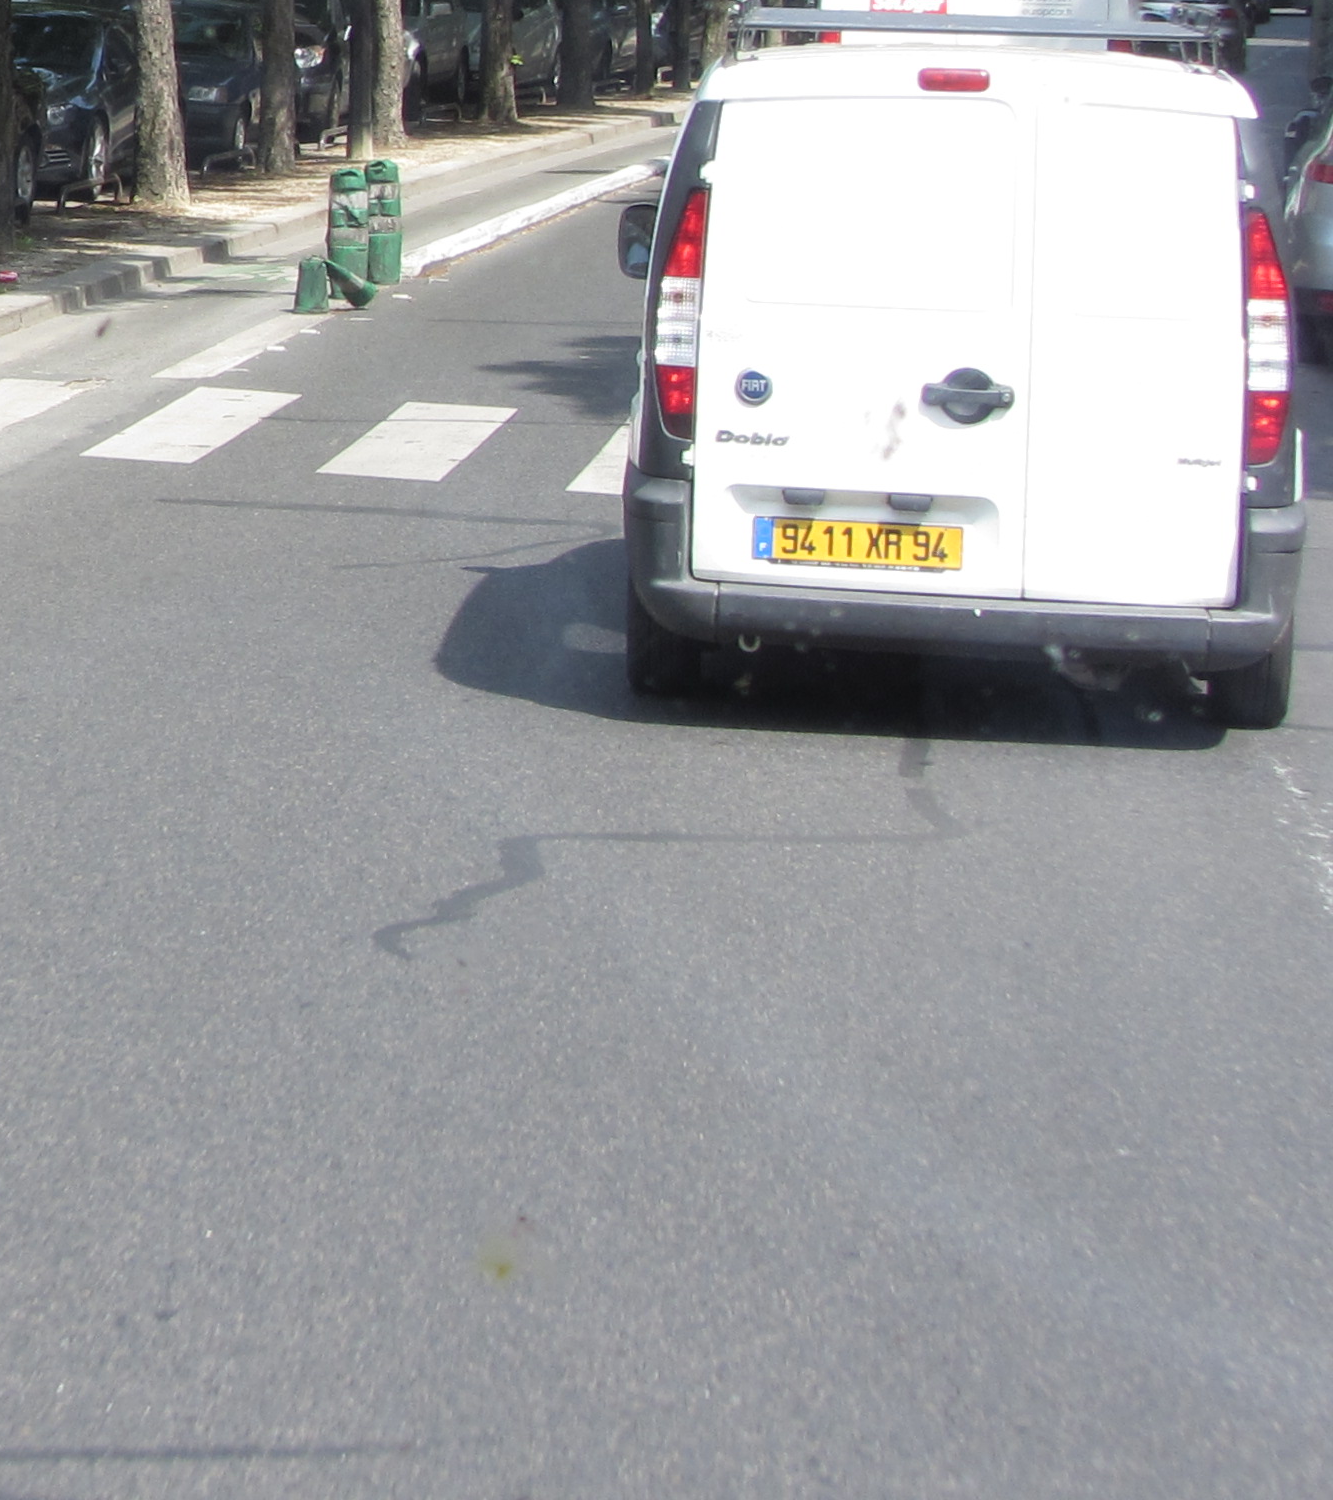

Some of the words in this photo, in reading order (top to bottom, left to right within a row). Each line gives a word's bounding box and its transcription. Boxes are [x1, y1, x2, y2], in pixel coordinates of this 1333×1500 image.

[741, 379, 767, 392] FIAT
[759, 542, 767, 551] F
[781, 523, 854, 558] 9411
[865, 527, 902, 561] XR
[912, 530, 949, 563] 94
